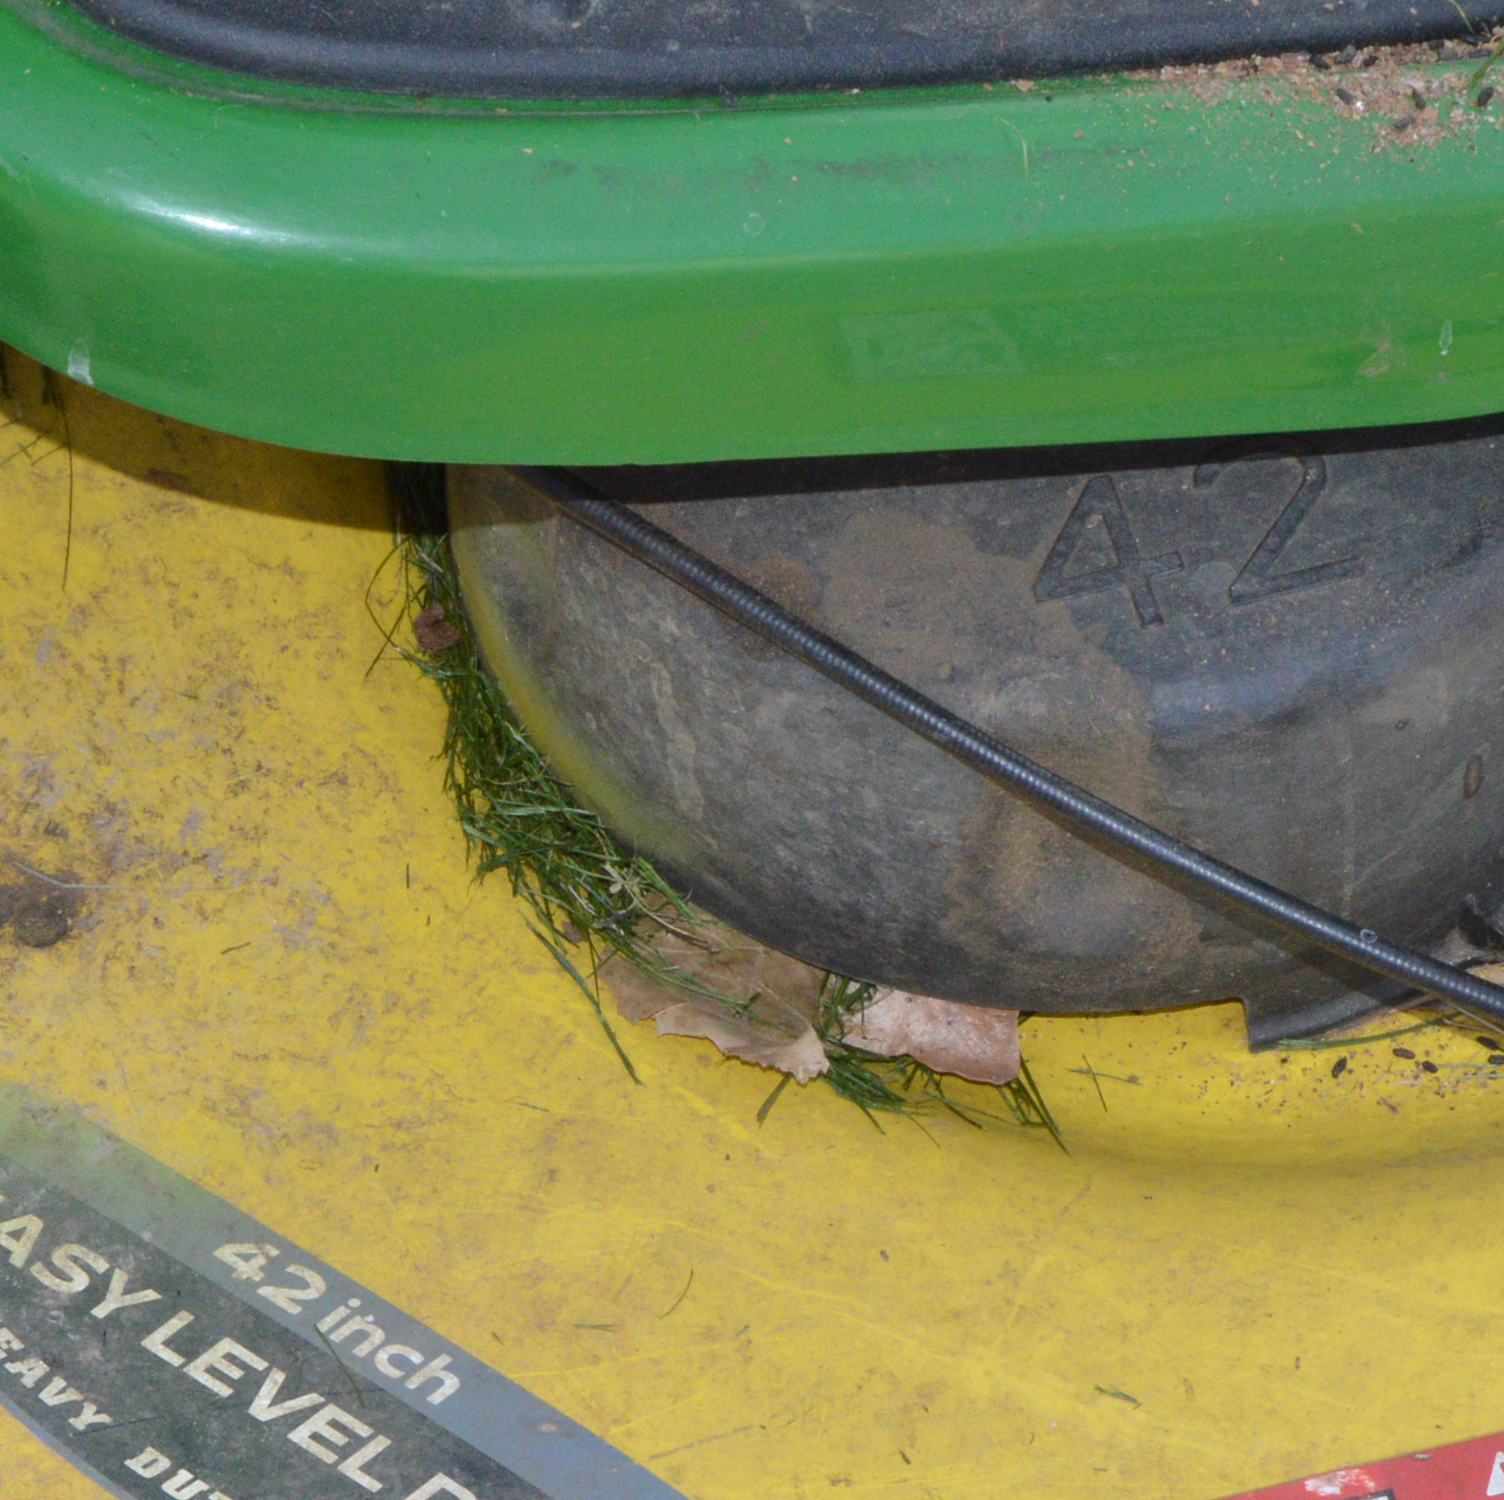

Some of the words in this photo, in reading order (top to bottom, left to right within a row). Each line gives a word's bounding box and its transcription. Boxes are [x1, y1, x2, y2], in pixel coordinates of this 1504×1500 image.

[1032, 437, 1366, 628] 42
[140, 1309, 392, 1494] LEVEL
[213, 1242, 327, 1316] 42
[315, 1297, 461, 1406] inch
